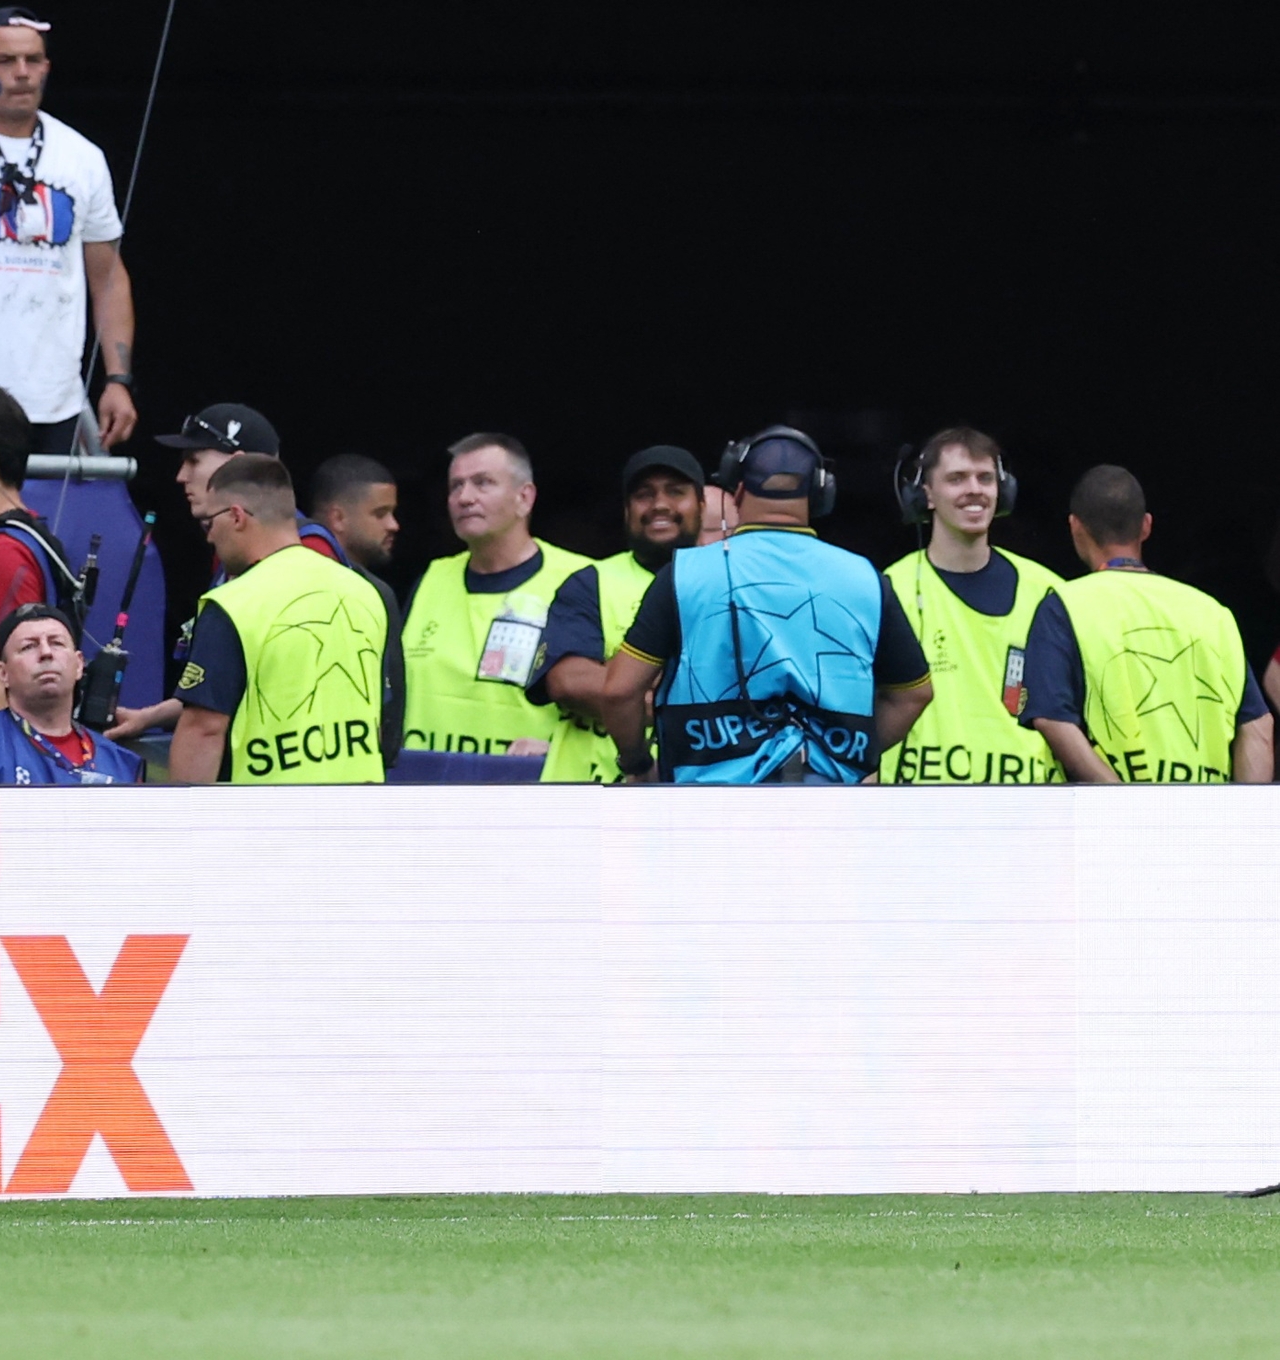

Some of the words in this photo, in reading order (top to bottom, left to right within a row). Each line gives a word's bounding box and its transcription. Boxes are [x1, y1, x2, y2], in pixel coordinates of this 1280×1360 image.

[246, 719, 372, 777] SECUR
[685, 704, 869, 762] SUPEOR
[900, 744, 1048, 784] SECURI
